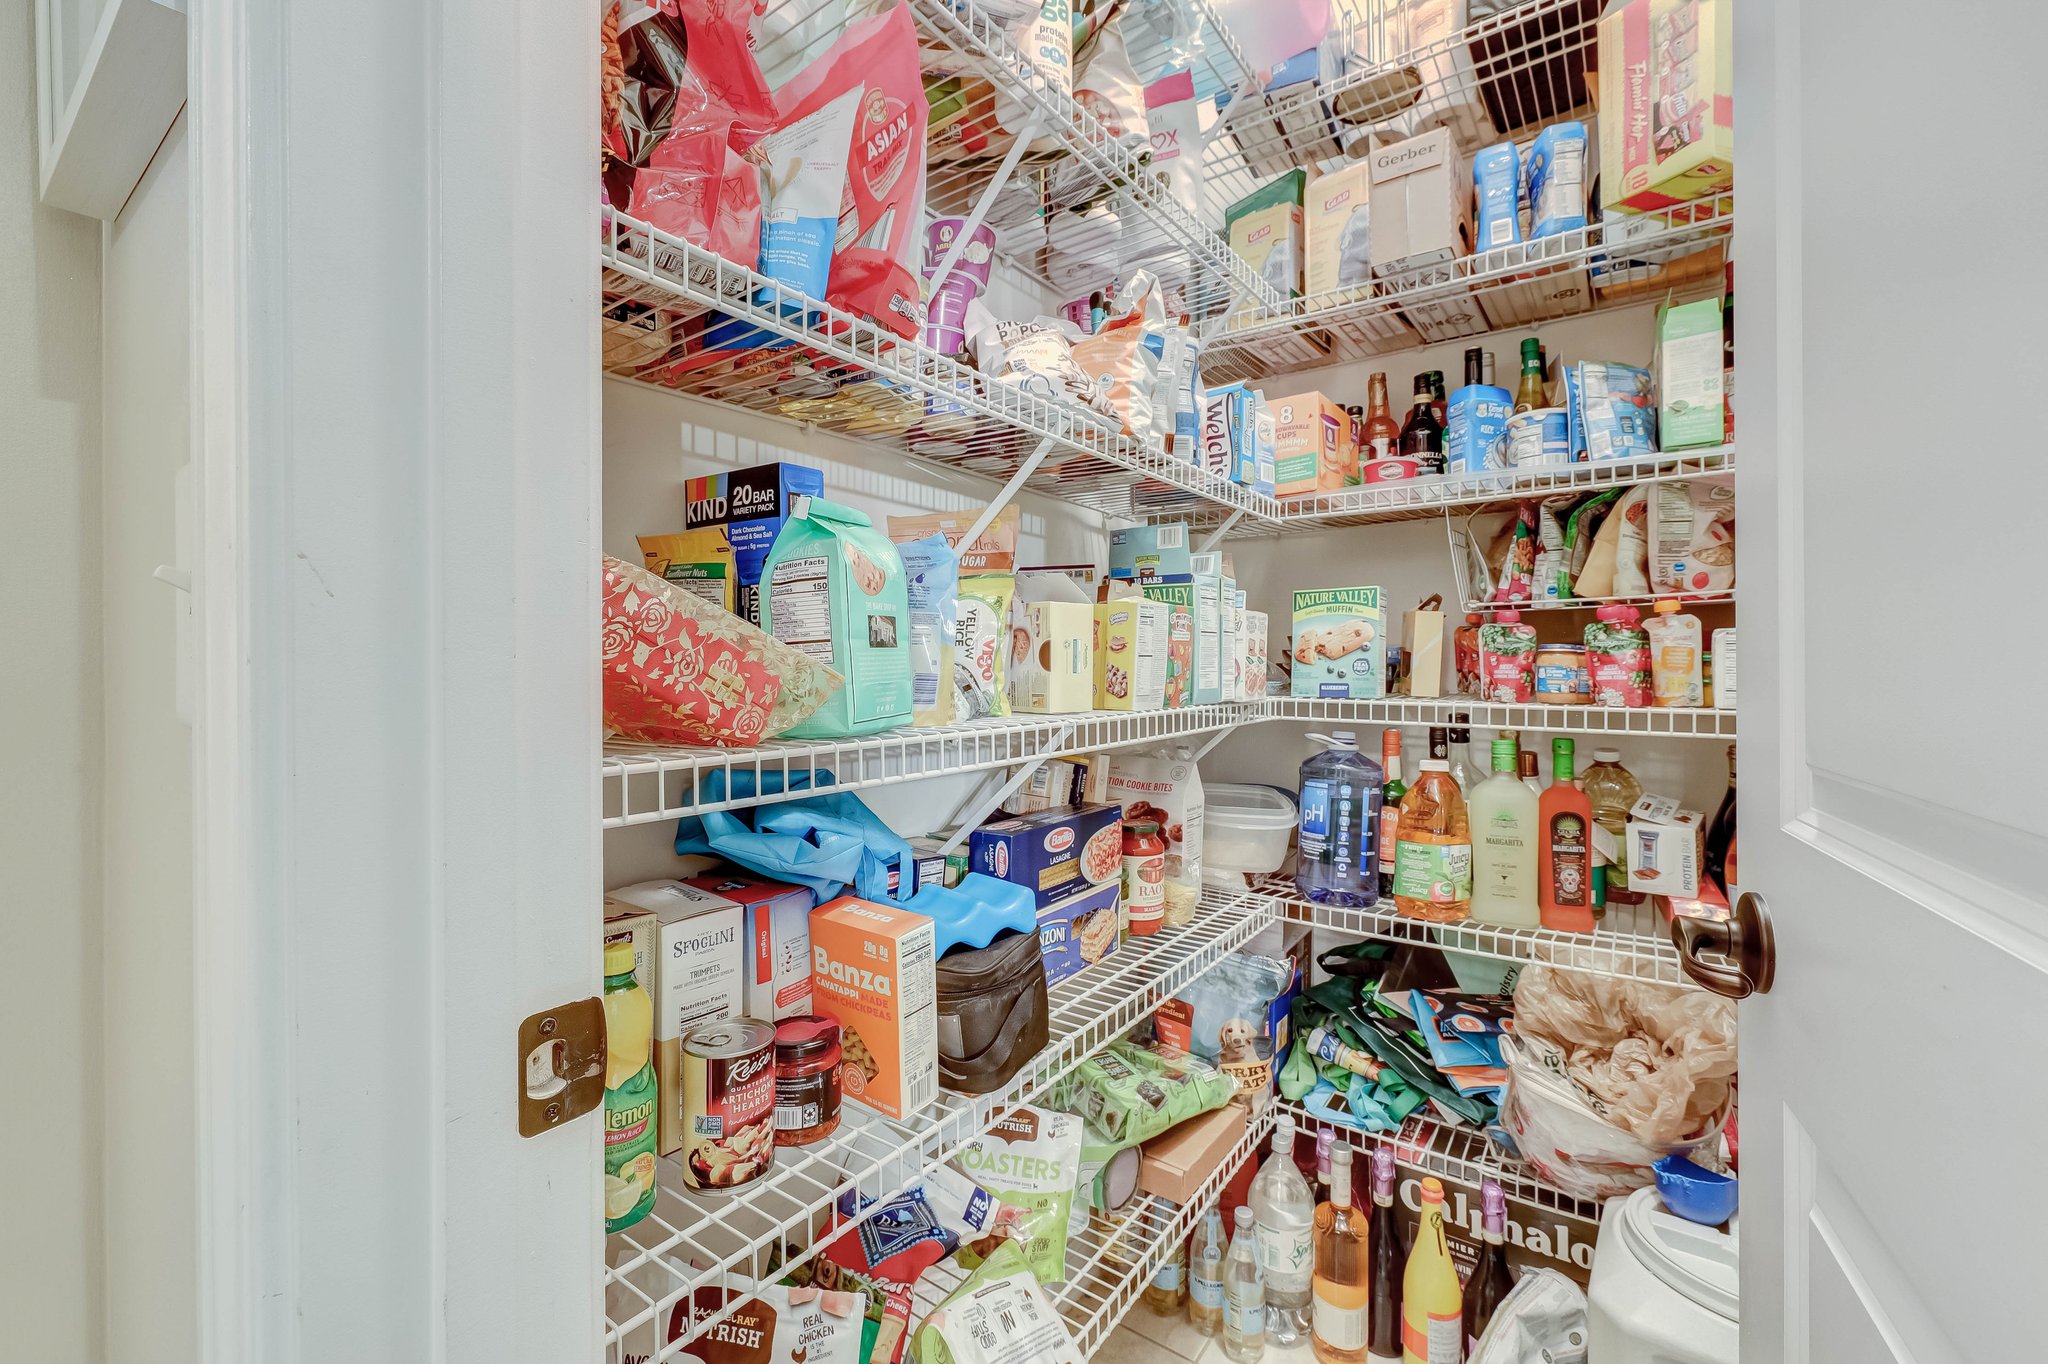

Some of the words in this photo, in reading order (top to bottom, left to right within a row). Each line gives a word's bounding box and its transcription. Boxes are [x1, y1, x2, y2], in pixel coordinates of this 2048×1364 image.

[1040, 25, 1068, 44] protein
[867, 111, 908, 161] ASIAN
[1378, 142, 1437, 170] Gerber
[1327, 191, 1349, 210] GLAD
[1249, 225, 1270, 242] GLAD
[1279, 405, 1294, 425] 8
[1205, 399, 1228, 480] Welch's
[1277, 430, 1297, 441] CUPS
[732, 484, 753, 507] 20
[752, 489, 775, 503] BAR
[687, 496, 728, 524] KIND
[732, 505, 757, 516] VARIETY
[757, 502, 775, 512] PACK
[731, 527, 743, 535] Dark
[743, 525, 766, 534] Chocolate
[731, 533, 749, 542] Almond
[753, 532, 763, 540] Sea
[984, 541, 1000, 551] rolls
[804, 558, 825, 567] Facts
[667, 570, 692, 578] Sunflower
[692, 569, 708, 577] Nuts
[1142, 576, 1163, 585] BARS
[772, 587, 793, 595] Calories
[812, 582, 828, 591] 150
[749, 584, 760, 624] KIND
[1150, 587, 1190, 607] VALLEY
[1295, 593, 1335, 611] NATURE
[1336, 590, 1375, 607] VALLEY
[1326, 606, 1354, 614] MUFFIN
[955, 619, 966, 647] RICE
[964, 608, 978, 660] YELLOW
[976, 639, 996, 681] Vigo
[1126, 780, 1152, 791] COOKIE
[1153, 782, 1173, 792] BITES
[1304, 804, 1324, 824] pH
[1051, 830, 1073, 846] Barilla
[1485, 837, 1524, 847] MARGARITA
[1552, 845, 1586, 853] MARGARITA
[1050, 851, 1071, 865] LASAGNE
[1449, 852, 1470, 866] Juicy
[1450, 864, 1468, 876] Juice
[1683, 851, 1692, 891] PROTEIN
[1409, 886, 1428, 895] Juicy
[842, 904, 896, 923] Banza
[673, 926, 735, 959] SFOGLINI
[863, 940, 877, 954] 20g
[879, 944, 889, 958] 8g
[690, 964, 721, 980] TRUMPETS
[813, 944, 891, 997] Banza
[816, 975, 860, 1000] CAVATAPPI
[860, 994, 889, 1008] MADE
[680, 999, 710, 1012] Nutrition
[710, 992, 728, 1003] Facts
[816, 988, 839, 1003] FROM
[840, 998, 892, 1022] CHICKPEAS
[715, 1010, 729, 1021] 200
[680, 1022, 703, 1033] Calories
[721, 1078, 774, 1105] ARTICHOKE
[730, 1074, 770, 1093] QUARTERED
[732, 1092, 769, 1114] HEARTS
[627, 1126, 643, 1139] JUICE
[738, 1314, 757, 1327] RAY
[803, 1314, 824, 1327] REAL
[799, 1326, 835, 1345] CHICKEN
[816, 1341, 825, 1349] THE
[808, 1350, 833, 1363] INGREDIENT
